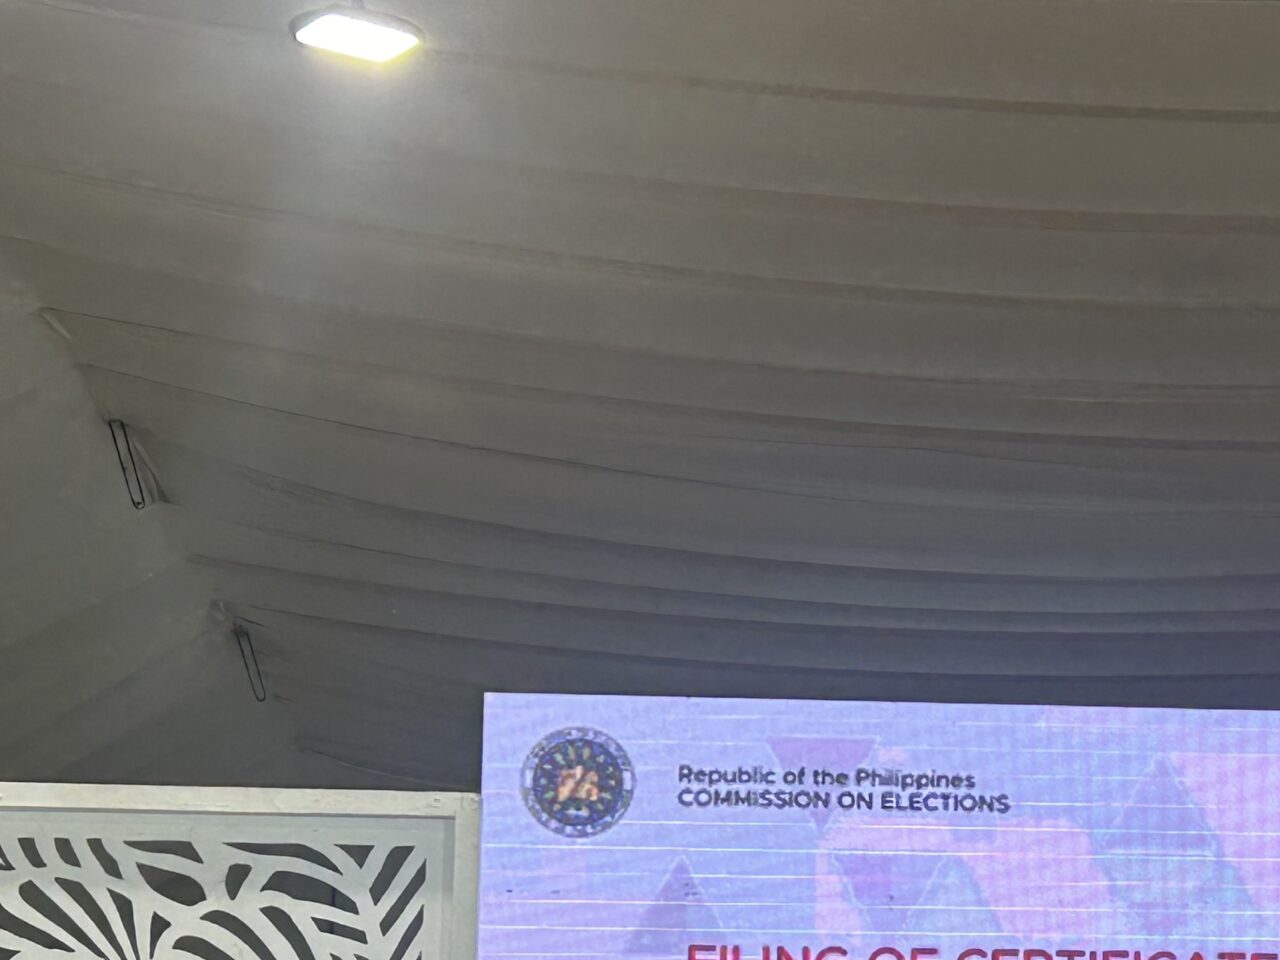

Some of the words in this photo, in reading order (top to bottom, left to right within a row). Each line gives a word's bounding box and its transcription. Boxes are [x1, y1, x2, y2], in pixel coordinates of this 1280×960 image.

[678, 765, 776, 787] Republic
[783, 766, 805, 785] of
[813, 767, 849, 786] the
[855, 768, 976, 791] Philippines
[677, 787, 830, 809] COMMISSION
[837, 790, 874, 810] ON
[880, 791, 1012, 814] ELECTIONS
